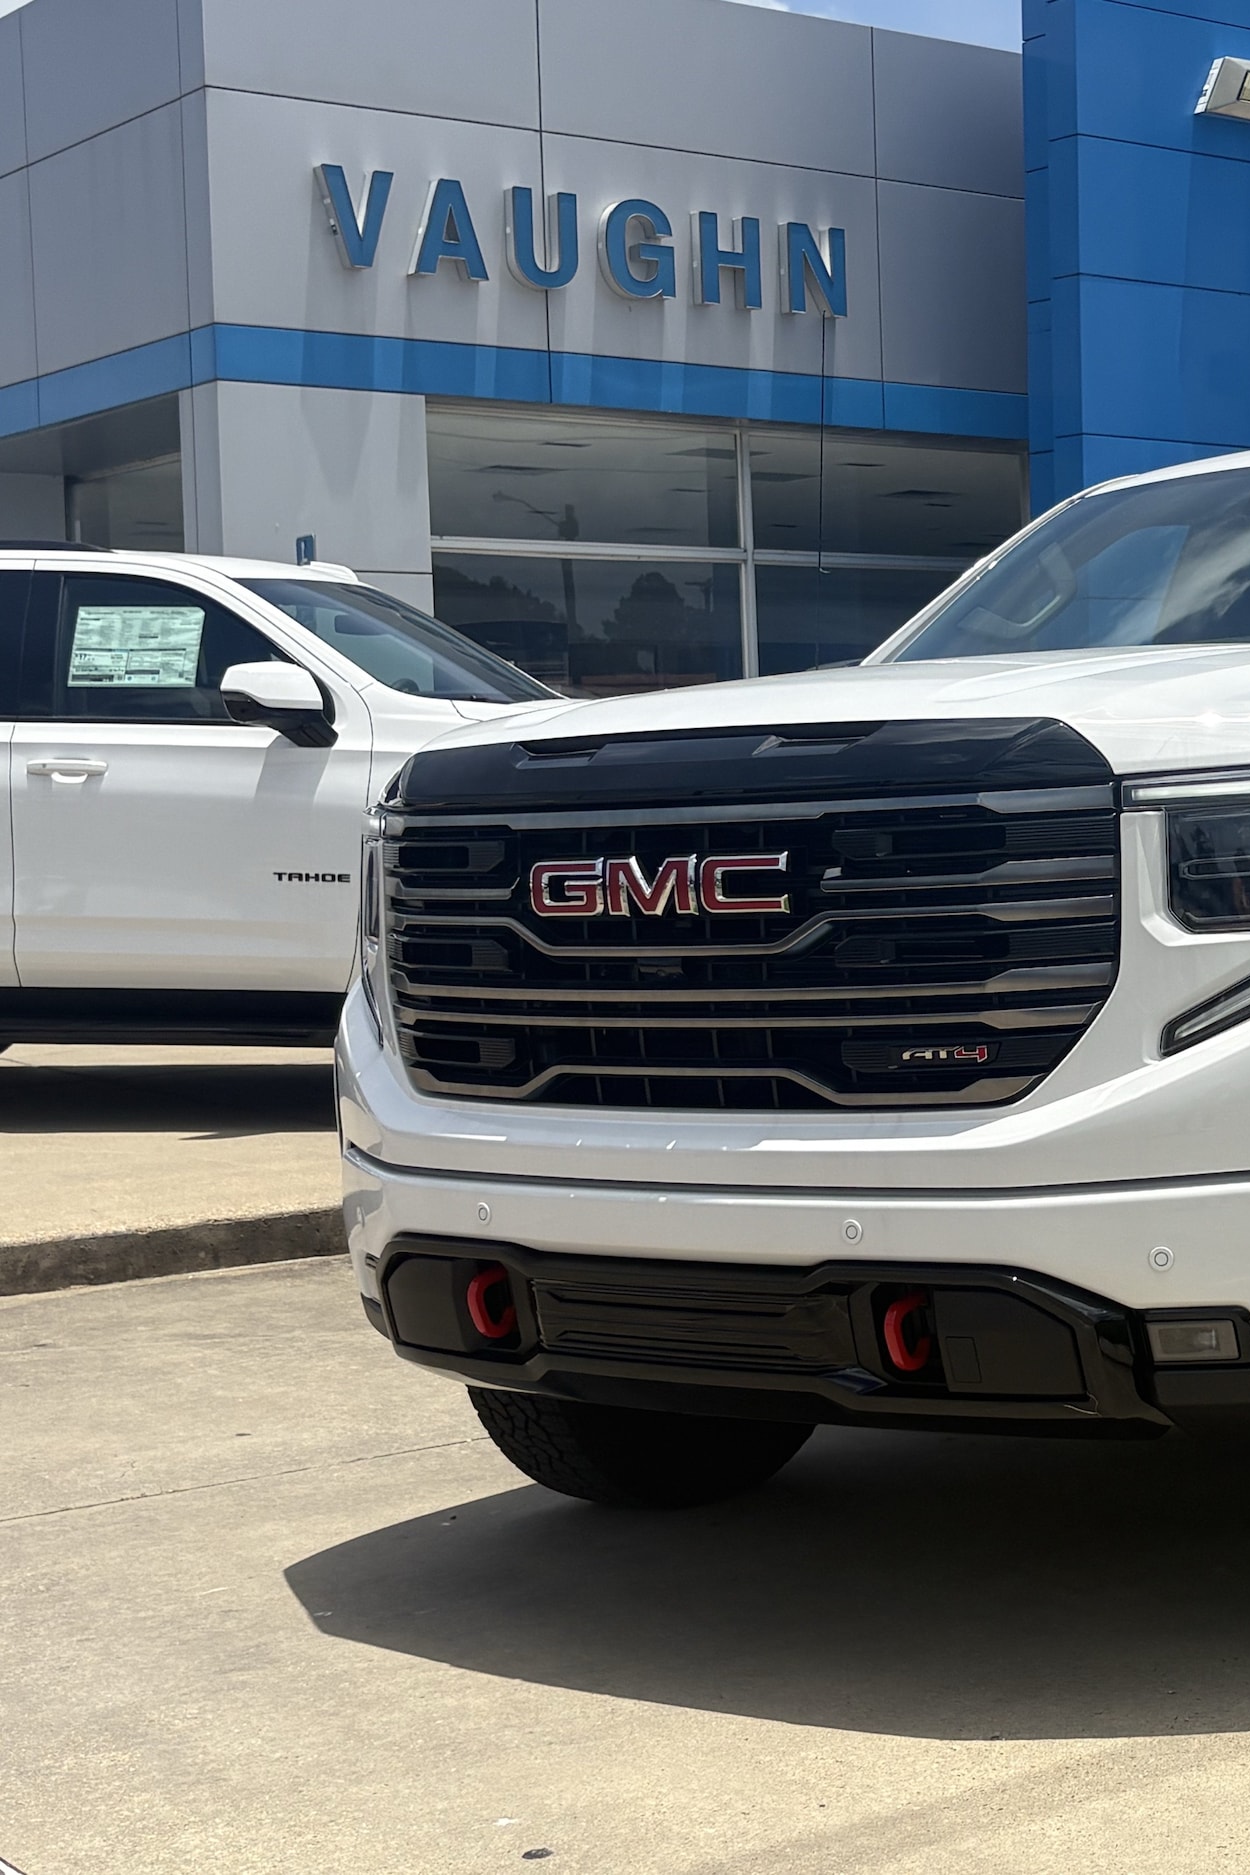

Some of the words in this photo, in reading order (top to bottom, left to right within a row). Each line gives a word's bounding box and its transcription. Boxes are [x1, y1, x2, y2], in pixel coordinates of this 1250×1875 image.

[312, 163, 848, 318] VAUGHN
[272, 871, 351, 883] TAHOE
[530, 850, 790, 916] GMC
[902, 1045, 988, 1063] AT4
